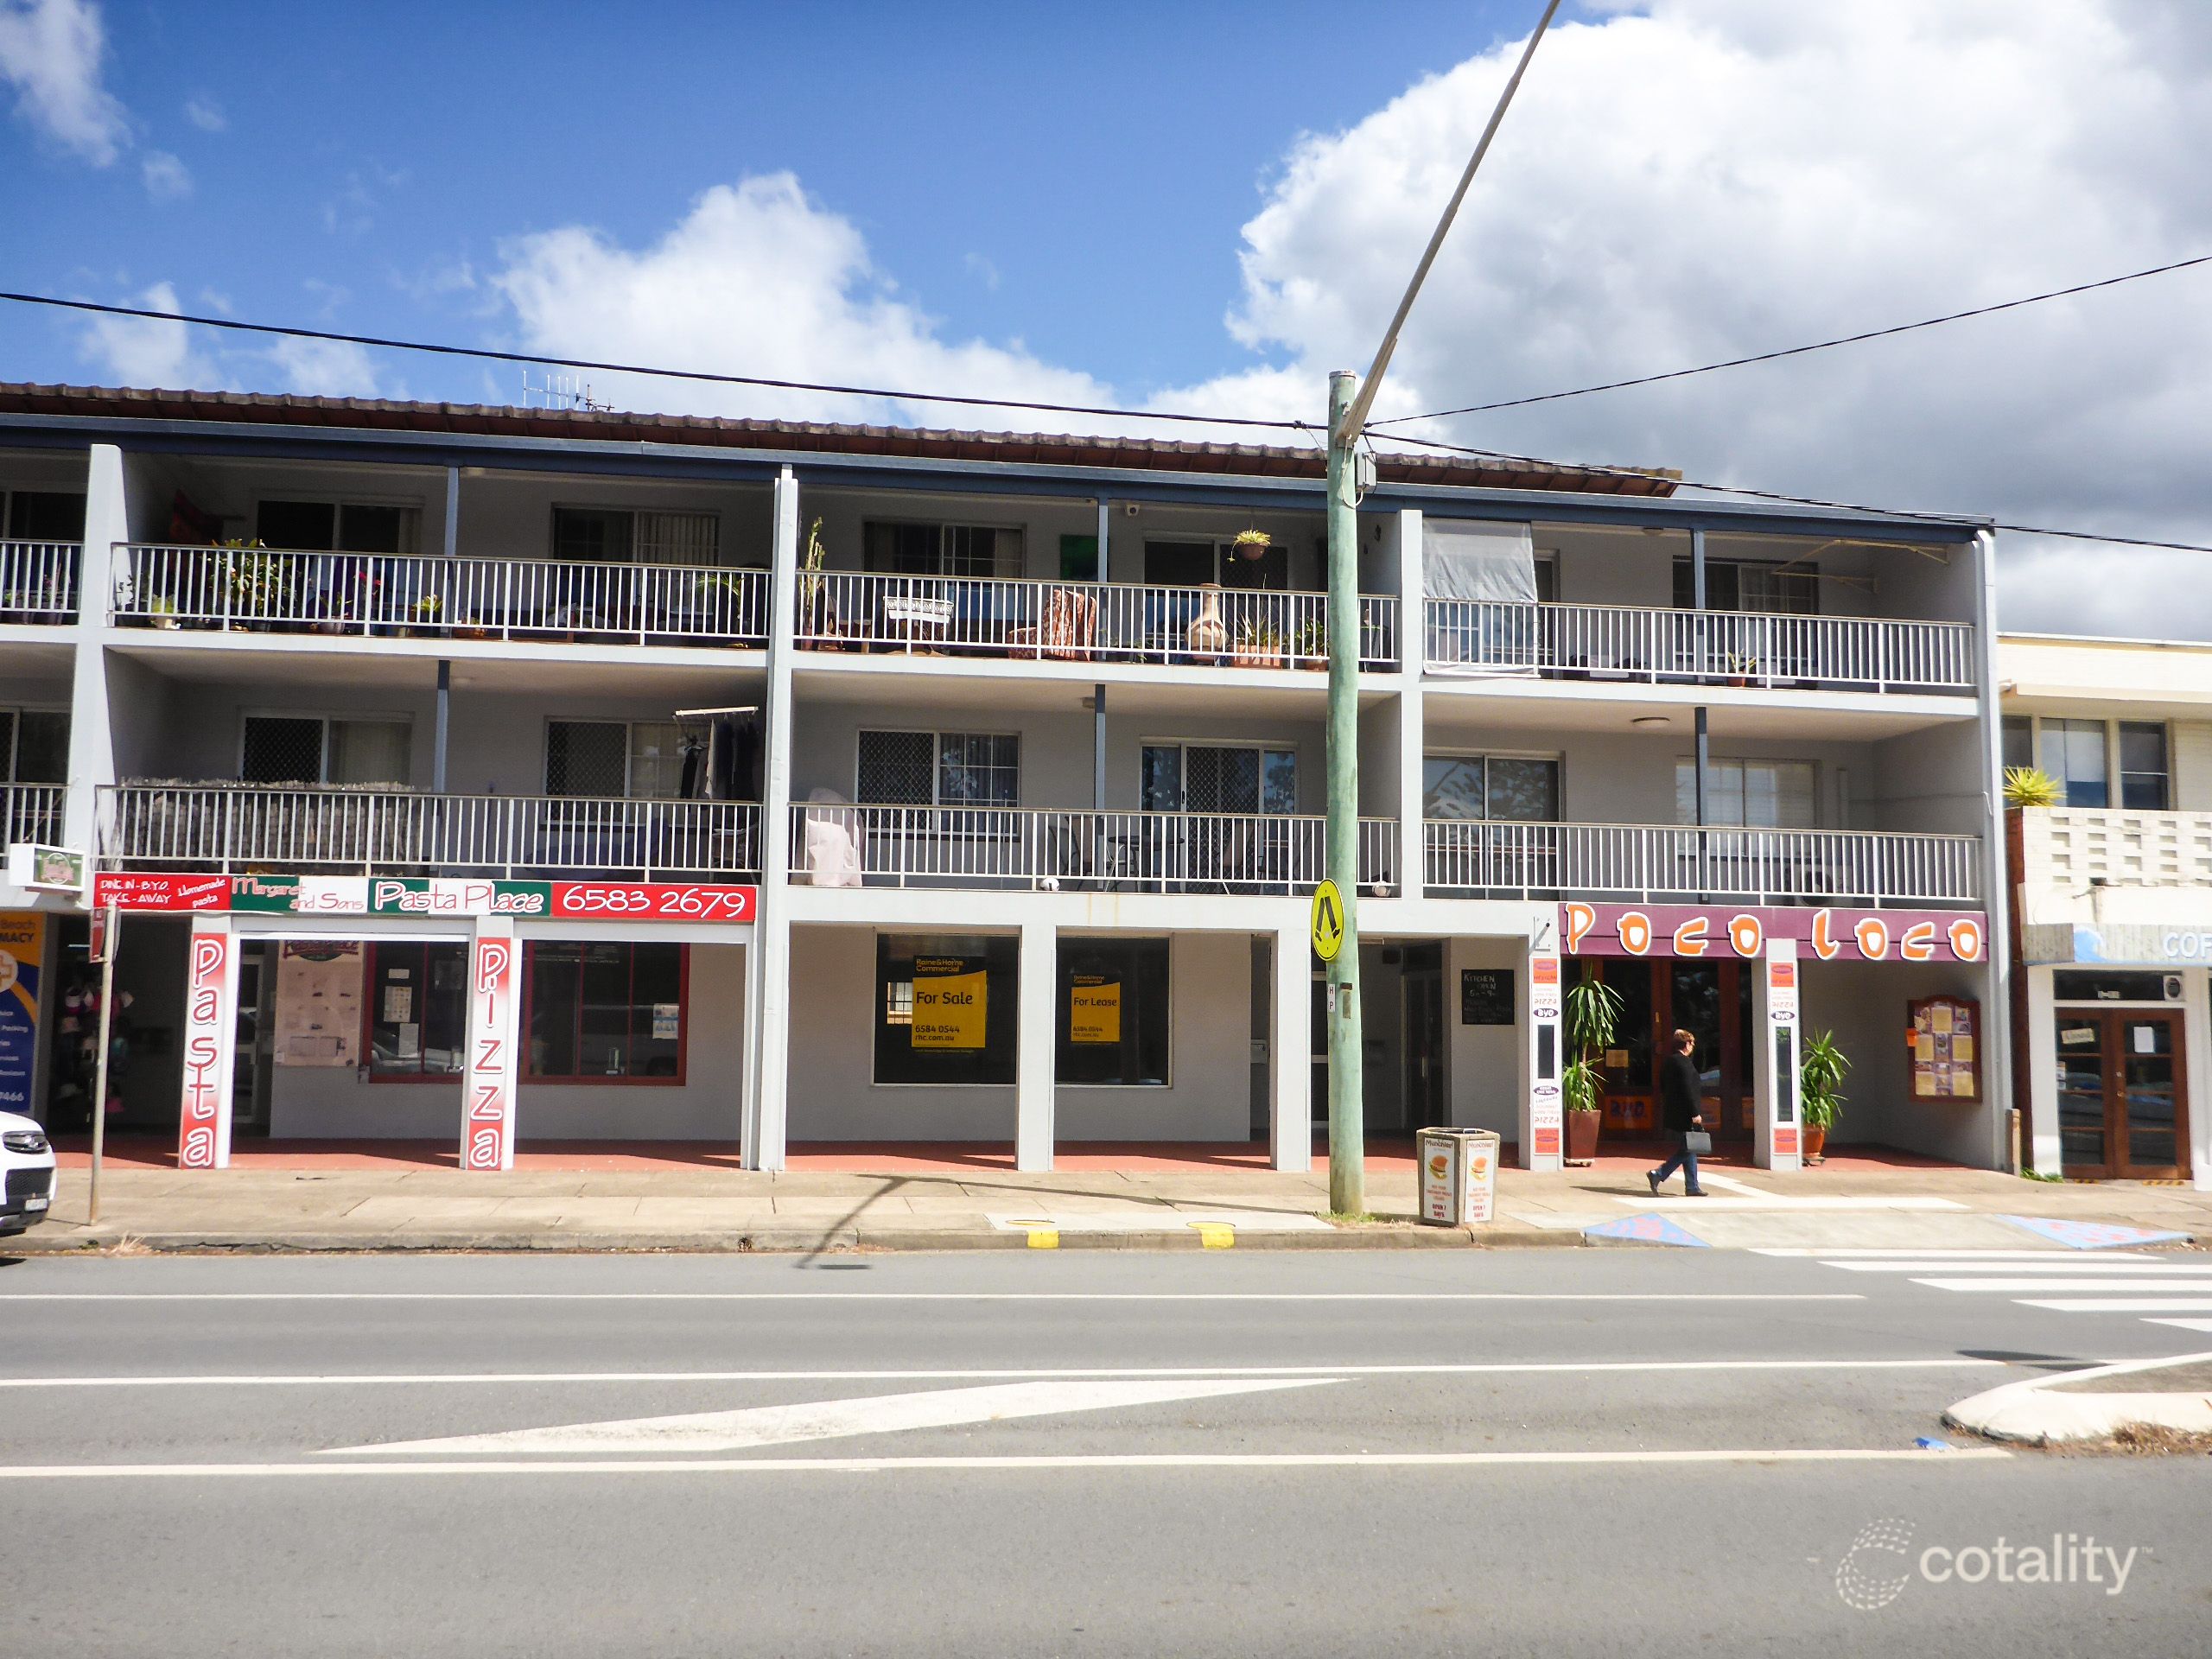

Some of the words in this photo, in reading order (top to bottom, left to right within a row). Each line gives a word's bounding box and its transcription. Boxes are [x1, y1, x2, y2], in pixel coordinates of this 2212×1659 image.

[177, 877, 226, 897] Homemade
[232, 876, 307, 898] Margaret
[192, 894, 219, 908] pasta
[289, 894, 315, 910] and
[319, 893, 364, 910] Sons
[375, 881, 457, 911] Pasta
[464, 883, 544, 913] Place
[563, 885, 651, 911] 6583
[659, 888, 746, 918] 2679
[916, 992, 938, 1004] For
[943, 992, 973, 1004] Sale
[1074, 997, 1089, 1006] For
[1537, 1008, 1554, 1017] BYO
[1775, 1011, 1791, 1020] BYO
[182, 938, 225, 1166] Pasta
[469, 944, 508, 1167] Pizza
